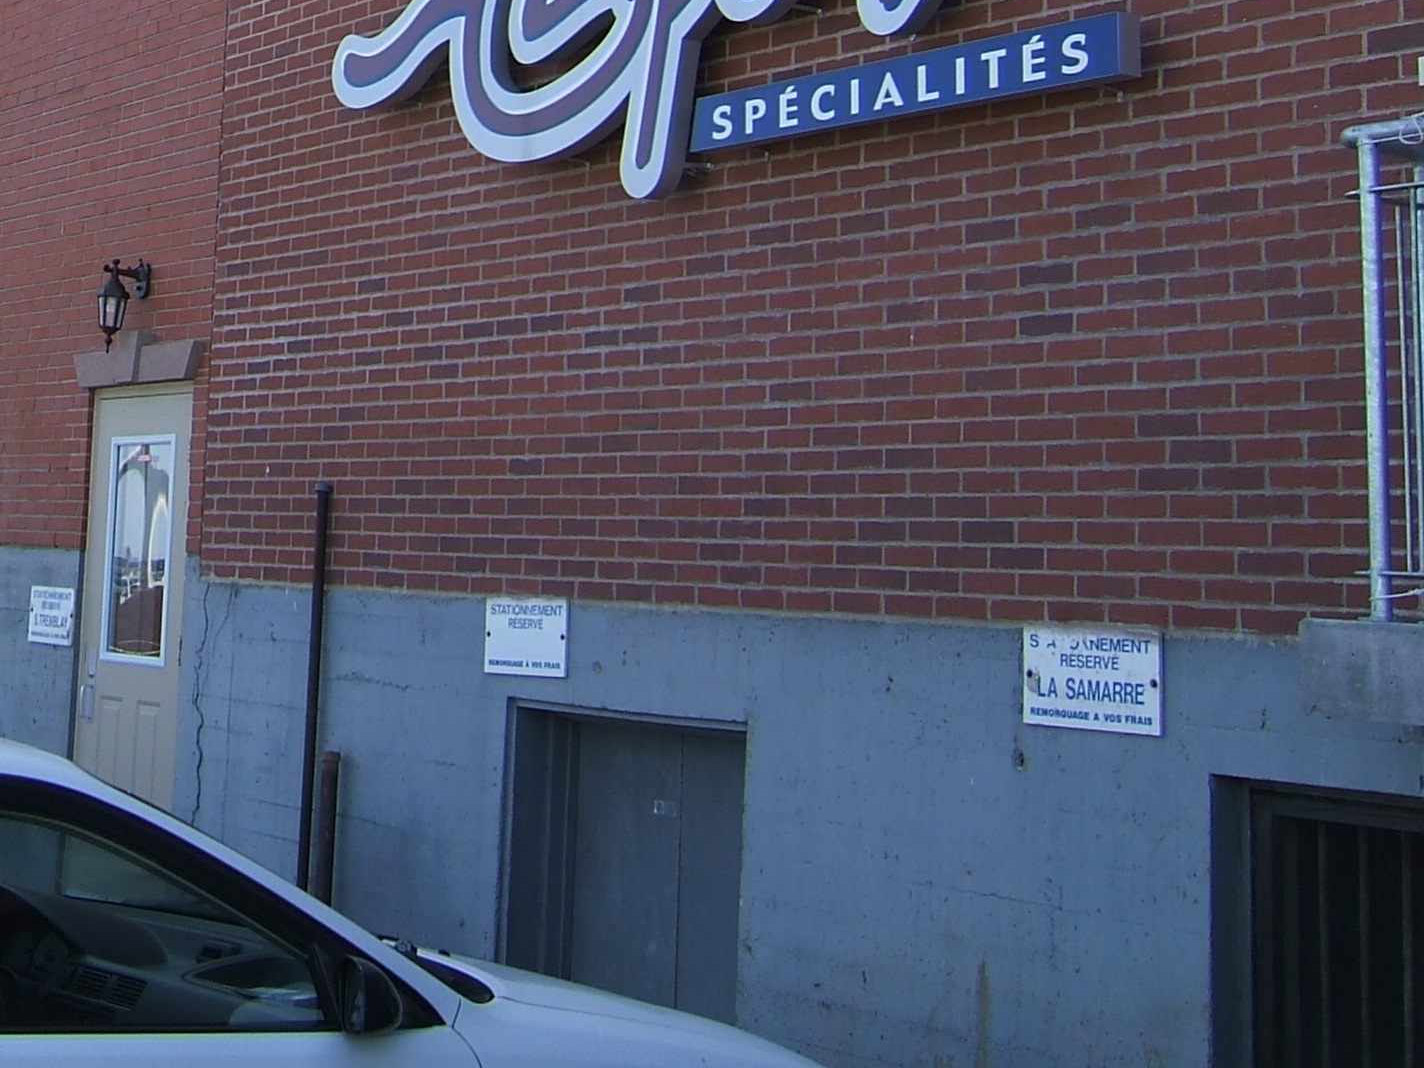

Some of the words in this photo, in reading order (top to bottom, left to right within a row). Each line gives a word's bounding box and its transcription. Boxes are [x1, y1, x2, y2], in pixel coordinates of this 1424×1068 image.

[712, 33, 1090, 140] SPÉCIALITÉS
[491, 604, 563, 616] STATIONNEMENT
[1037, 676, 1058, 698] LA
[1065, 677, 1145, 705] SAMARRE
[1030, 706, 1090, 721] REMORQUAGE
[1103, 712, 1122, 723] VOS
[1126, 714, 1153, 726] FRAIS
